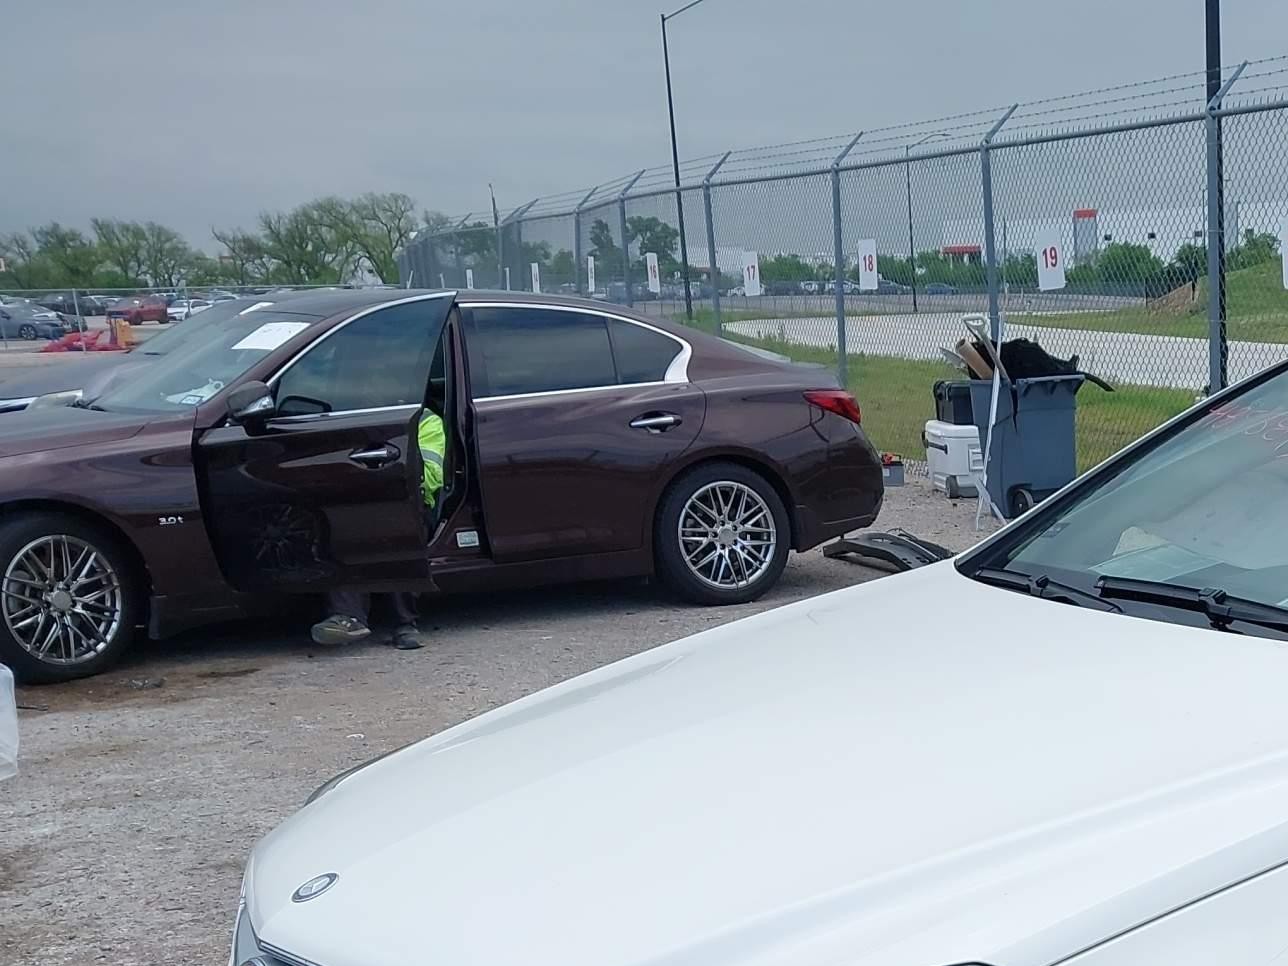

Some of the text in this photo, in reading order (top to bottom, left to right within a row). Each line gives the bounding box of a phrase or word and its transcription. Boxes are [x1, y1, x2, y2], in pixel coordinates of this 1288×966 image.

[862, 254, 874, 272] 18
[1042, 246, 1058, 268] 19
[649, 264, 658, 279] 16
[746, 265, 756, 280] 17
